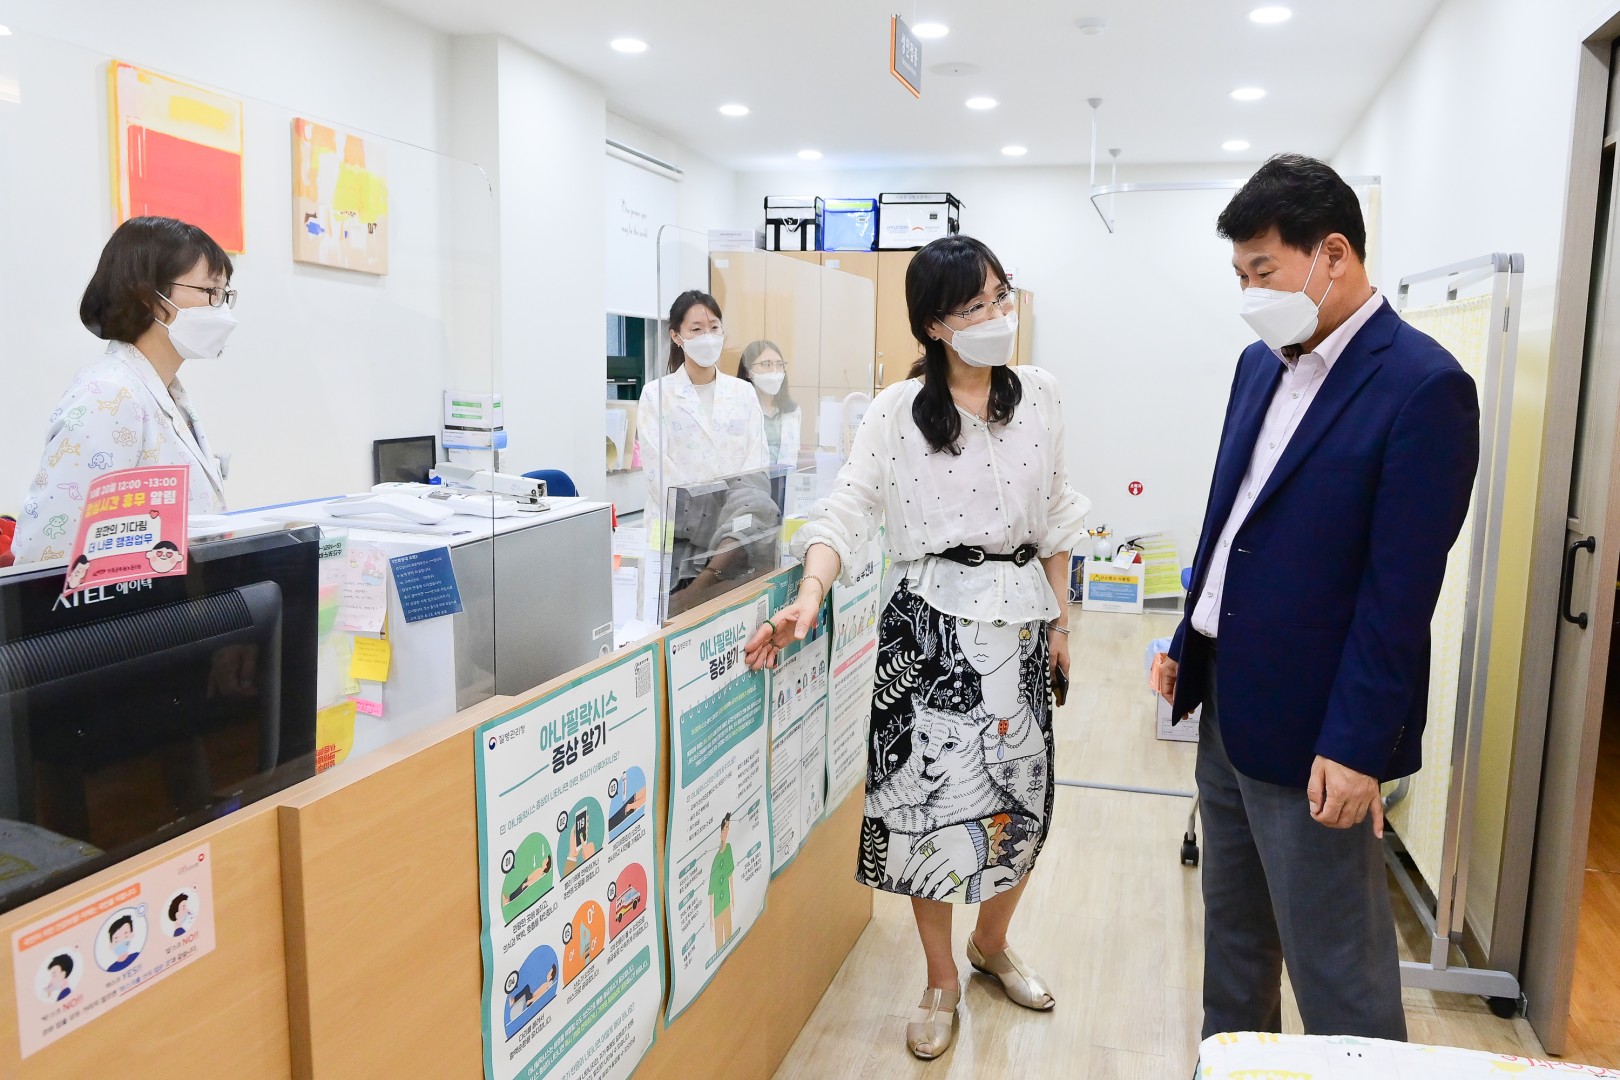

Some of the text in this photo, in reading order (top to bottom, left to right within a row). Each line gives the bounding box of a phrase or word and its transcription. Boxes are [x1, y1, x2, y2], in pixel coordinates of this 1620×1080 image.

[118, 480, 140, 491] 12:00
[122, 492, 146, 509] 휴무
[150, 490, 176, 505] 알림
[95, 520, 148, 538] 잠깐의 기다림
[88, 533, 153, 553] 더 나은 행정업무
[116, 578, 152, 594] 에이텍
[700, 621, 746, 662] 아나필락시스
[709, 644, 739, 680] 증상 알기
[540, 690, 618, 751] 아나필락시스
[498, 724, 526, 744] 질병관리청
[552, 721, 606, 774] 증상 알기
[610, 784, 616, 792] 03
[560, 816, 565, 826] 02
[576, 817, 585, 832] 119
[505, 856, 511, 866] 01
[564, 929, 570, 937] 05
[508, 976, 515, 988] 04
